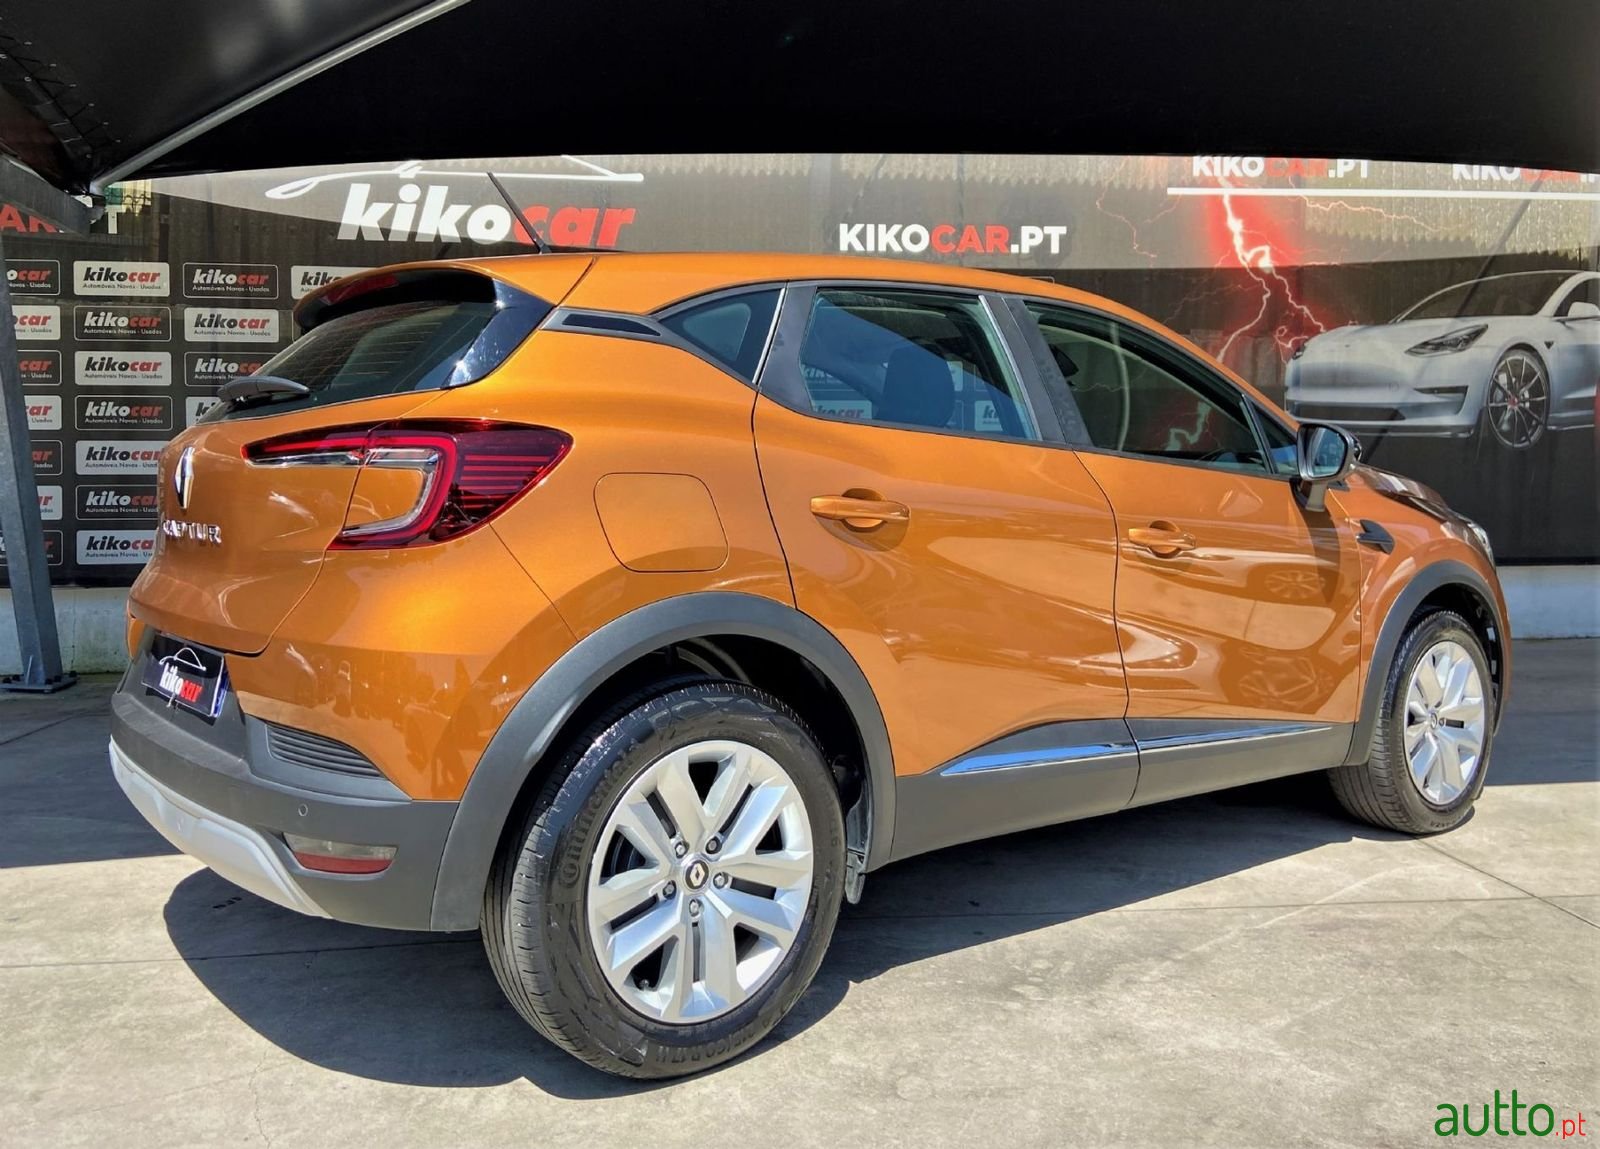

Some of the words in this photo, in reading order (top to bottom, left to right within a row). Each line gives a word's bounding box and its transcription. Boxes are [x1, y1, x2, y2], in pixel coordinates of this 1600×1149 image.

[337, 183, 636, 246] kikocar
[839, 224, 1067, 254] KIKOCAR.PT
[6, 268, 52, 281] ocar
[83, 266, 161, 282] kikocar
[192, 268, 270, 285] kikocar
[84, 311, 161, 327] kikocar
[194, 313, 270, 330] kikocar
[85, 356, 162, 372] kikocar
[194, 358, 263, 373] kikoca
[85, 401, 163, 417] kikocar
[86, 535, 154, 551] kikoca
[159, 662, 203, 703] kikocar
